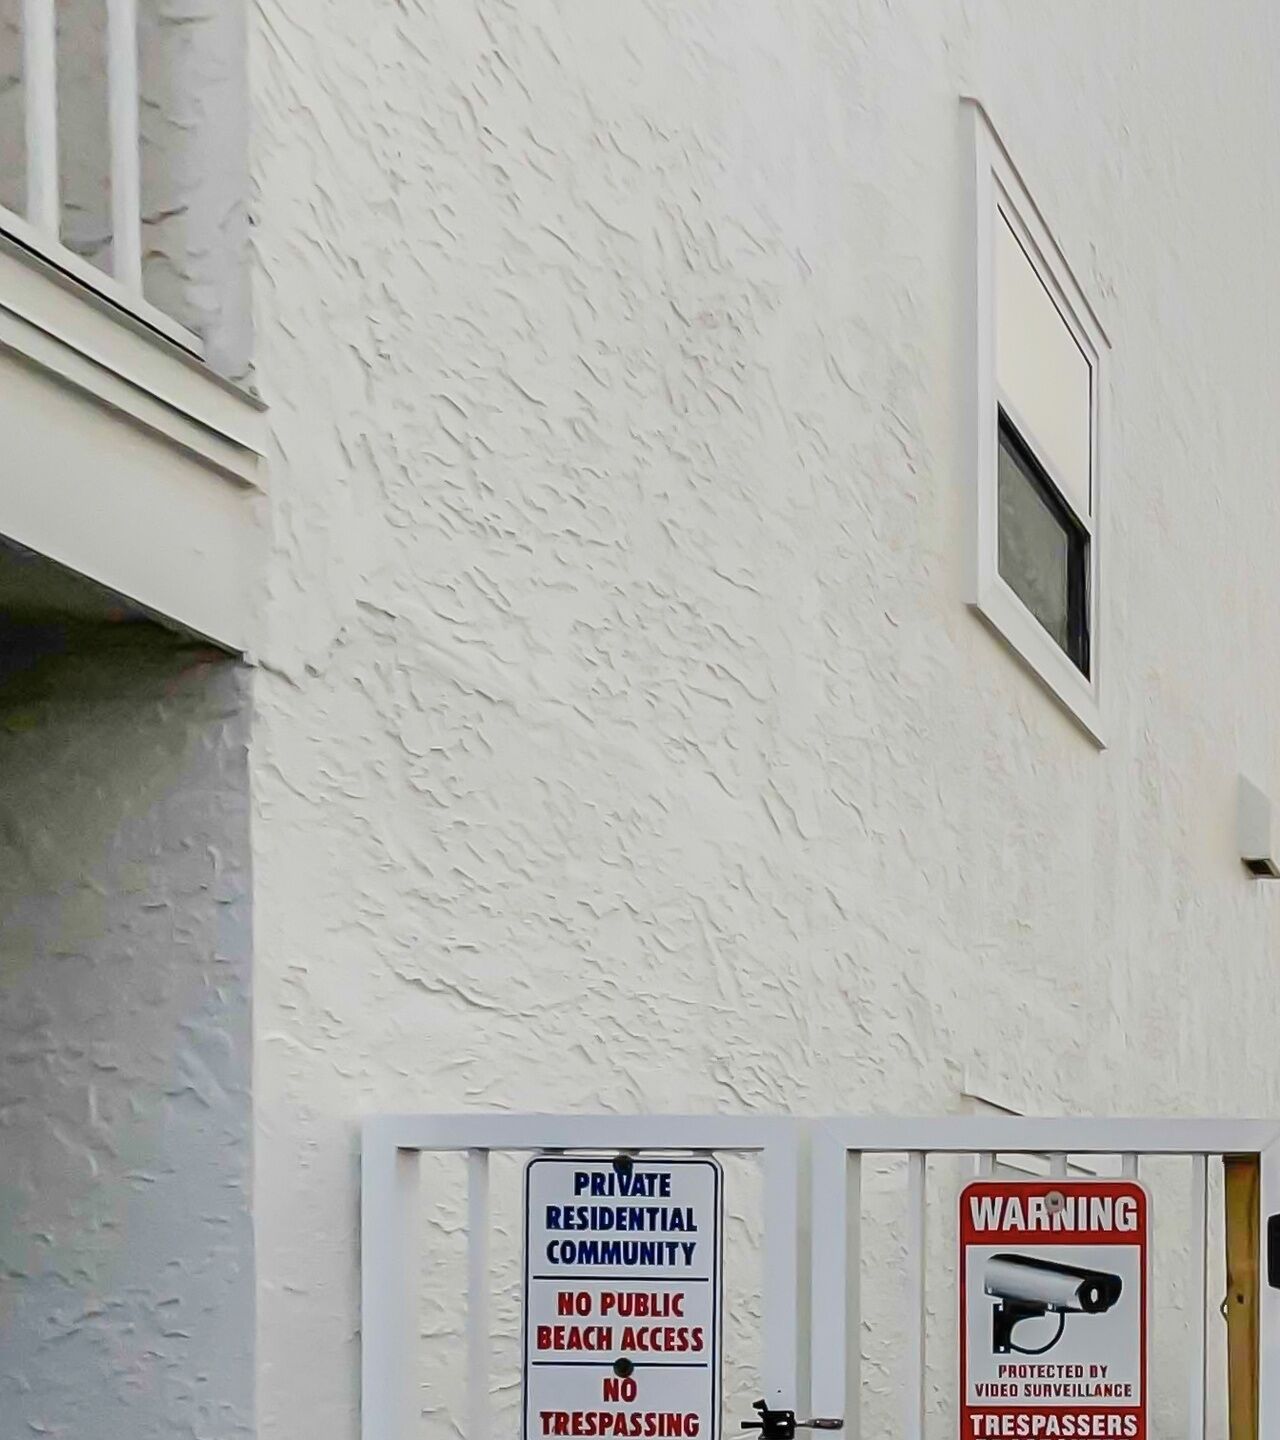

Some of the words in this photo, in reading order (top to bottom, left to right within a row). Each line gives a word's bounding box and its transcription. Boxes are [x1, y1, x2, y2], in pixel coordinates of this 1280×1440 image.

[574, 1172, 671, 1196] PRIVATE
[546, 1206, 697, 1232] RESIDENTIAL
[970, 1196, 1137, 1232] WARNING
[546, 1240, 696, 1265] COMMUNITY
[558, 1292, 592, 1315] NO
[600, 1292, 684, 1317] PUBLIC
[537, 1326, 612, 1350] BEACH
[621, 1327, 703, 1351] ACCESS
[998, 1365, 1083, 1378] PROTECTED
[1090, 1366, 1108, 1378] BY
[604, 1378, 637, 1401] NO
[975, 1384, 1018, 1397] VIDEO
[1024, 1384, 1132, 1398] SURVEILLANCE
[540, 1412, 699, 1437] TRESPASSING
[970, 1414, 1138, 1436] TRESPASSERS
